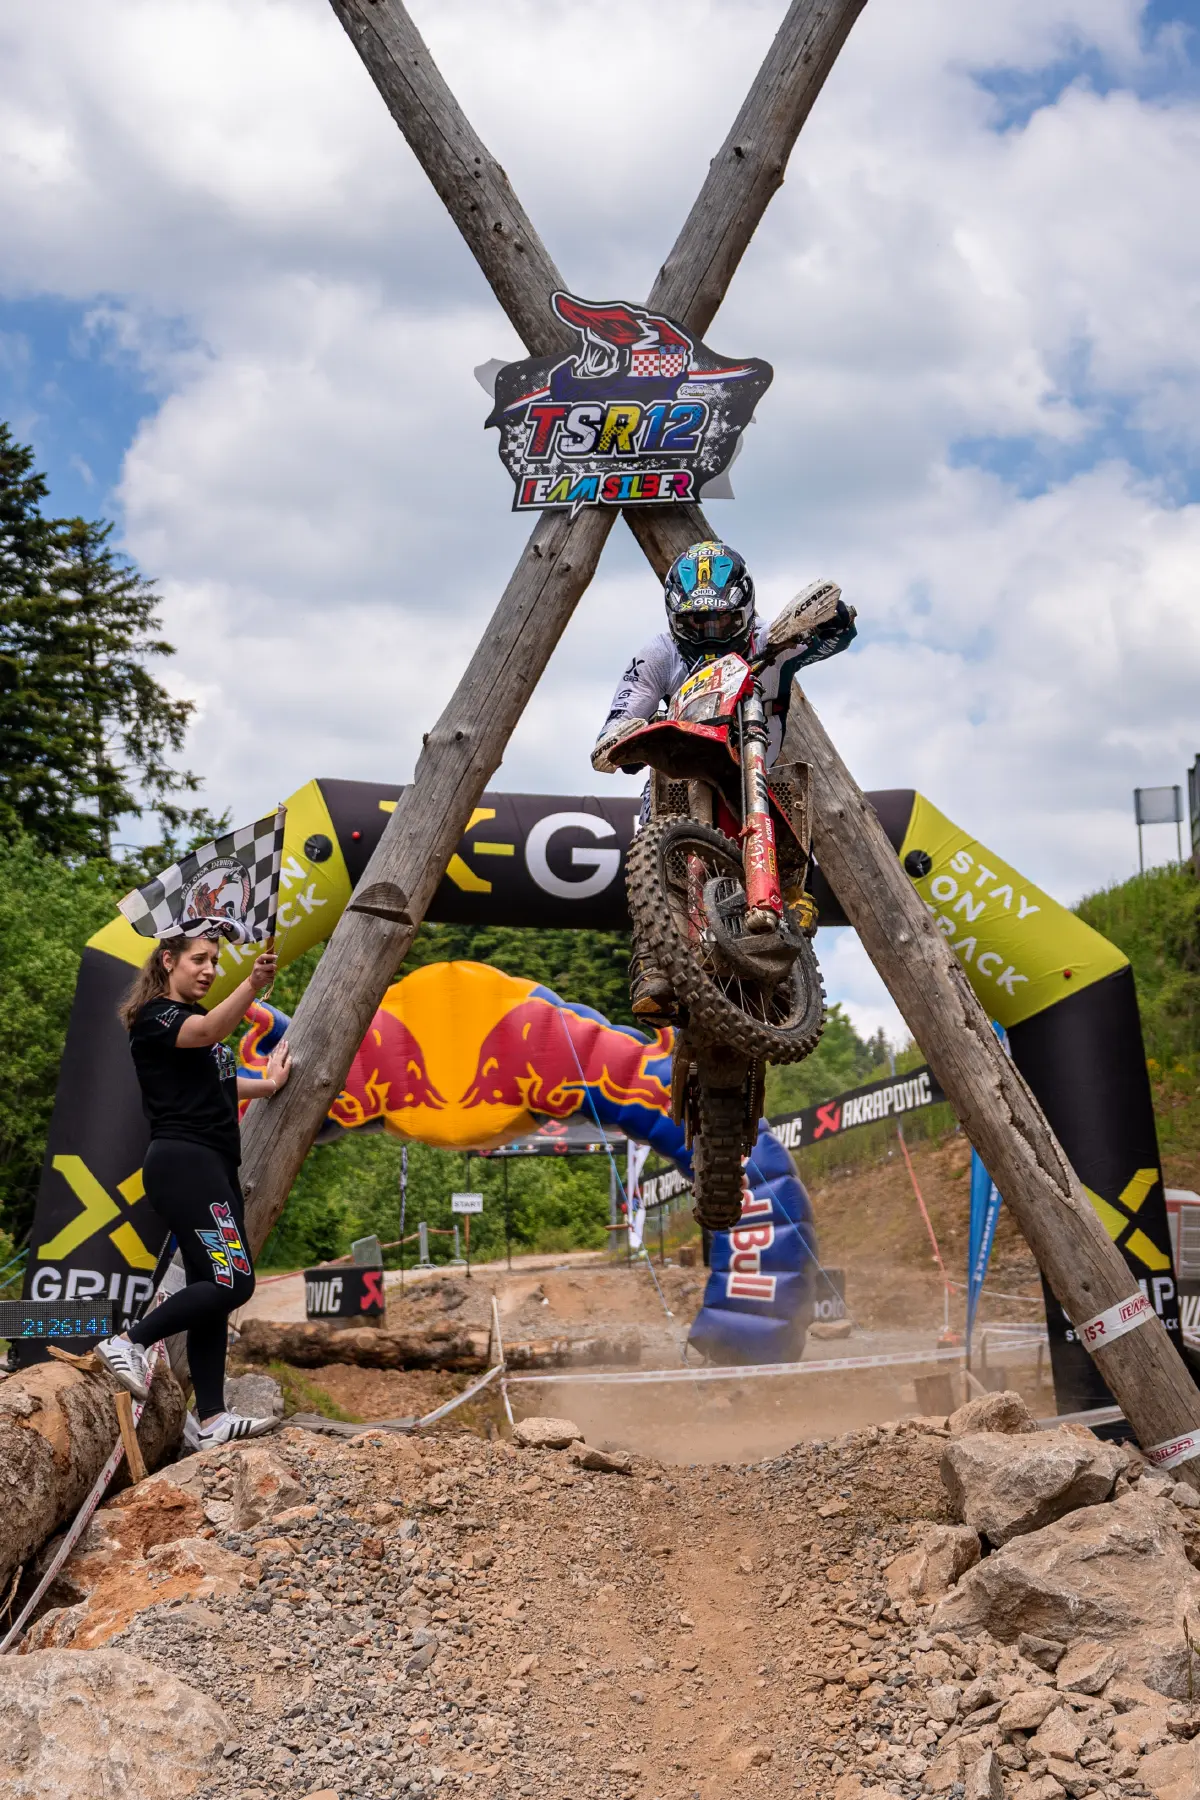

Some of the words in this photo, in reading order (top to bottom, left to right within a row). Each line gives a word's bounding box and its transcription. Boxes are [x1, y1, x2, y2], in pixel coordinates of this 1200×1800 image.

[527, 402, 706, 456] TSR12
[603, 474, 692, 500] SILBER
[694, 598, 727, 608] GRIP
[279, 856, 307, 889] N
[950, 850, 1041, 920] STAY
[931, 875, 986, 922] ON
[211, 1203, 250, 1273] SILBER
[726, 1222, 776, 1303] Bull
[31, 1266, 154, 1314] GRIP
[22, 1317, 109, 1336] 2:26:41
